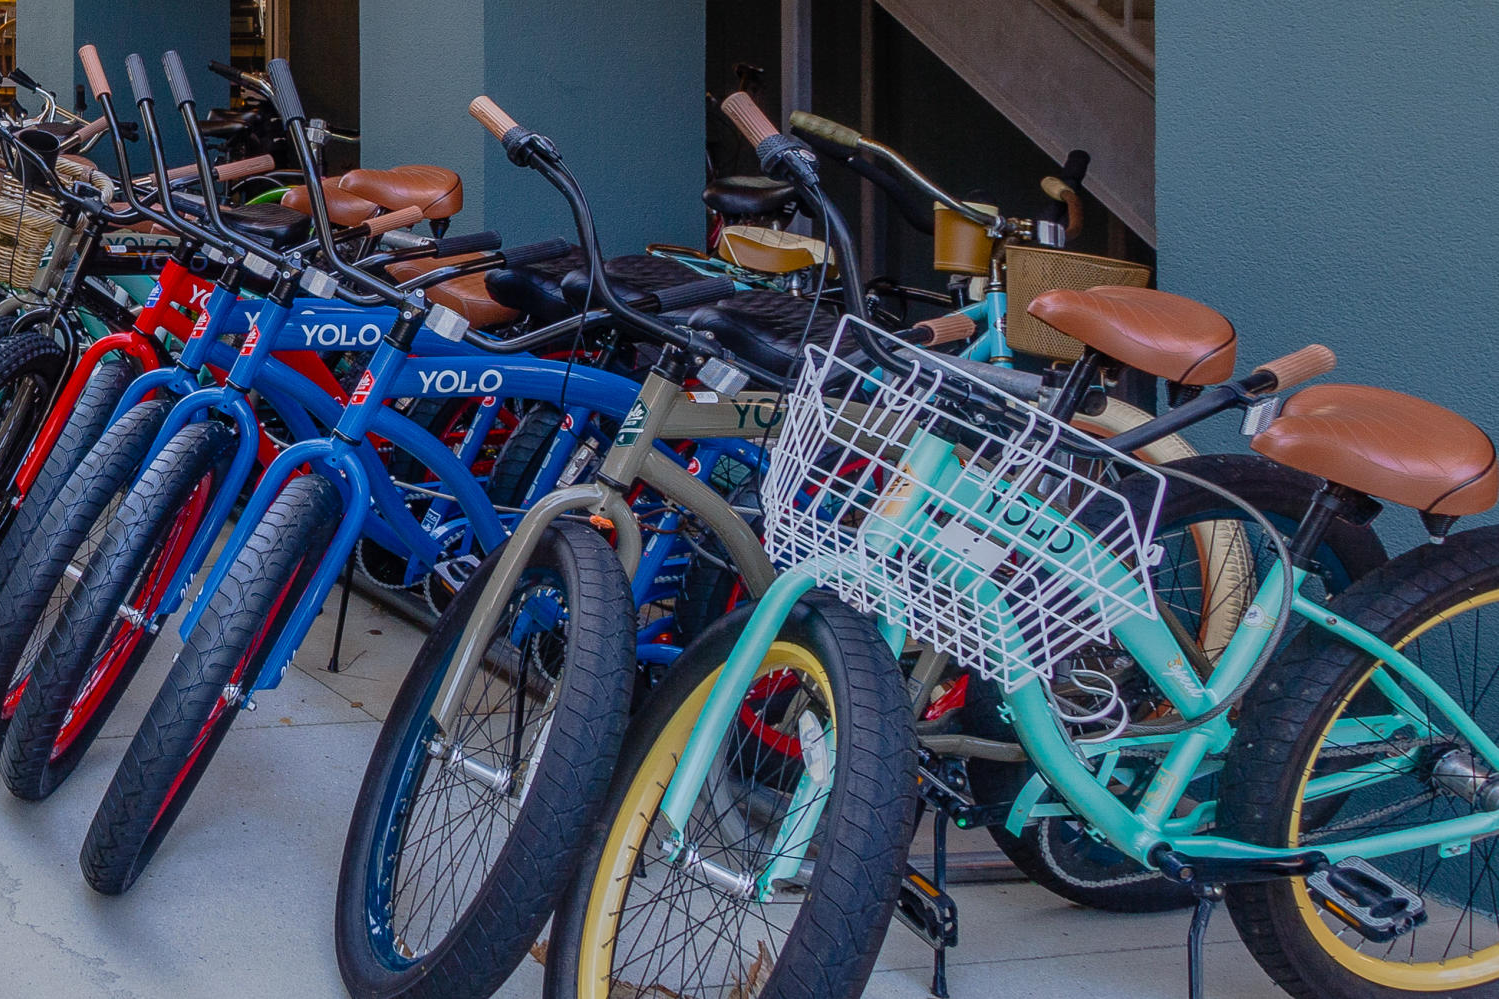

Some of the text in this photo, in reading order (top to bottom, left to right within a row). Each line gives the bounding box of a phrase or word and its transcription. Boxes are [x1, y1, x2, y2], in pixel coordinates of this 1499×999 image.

[137, 249, 209, 272] YOO
[301, 323, 381, 347] YOLO
[418, 369, 503, 394] YOLO
[985, 485, 1075, 554] YOLO
